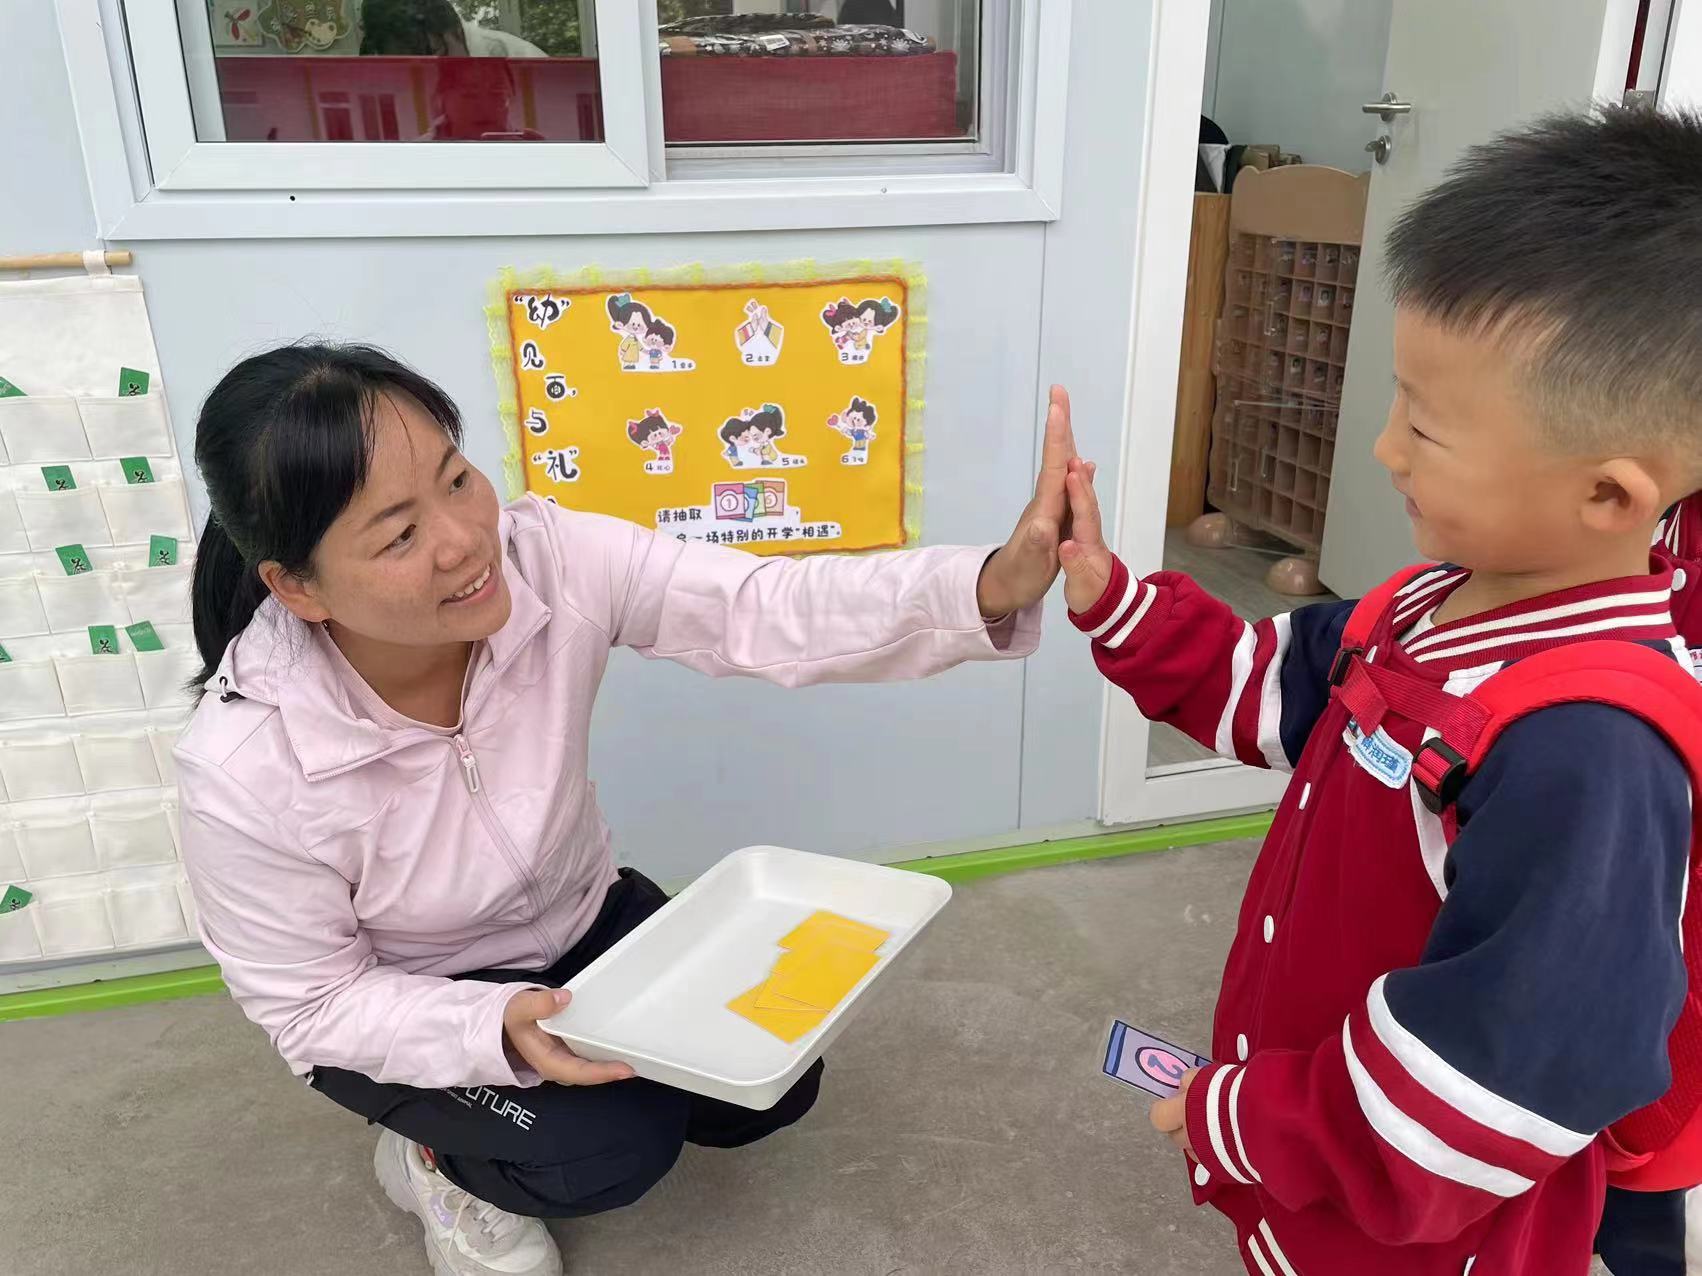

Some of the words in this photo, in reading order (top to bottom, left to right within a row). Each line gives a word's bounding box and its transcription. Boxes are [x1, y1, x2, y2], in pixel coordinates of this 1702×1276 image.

[658, 508, 702, 523] 请抽取
[456, 1086, 536, 1131] UTURE
